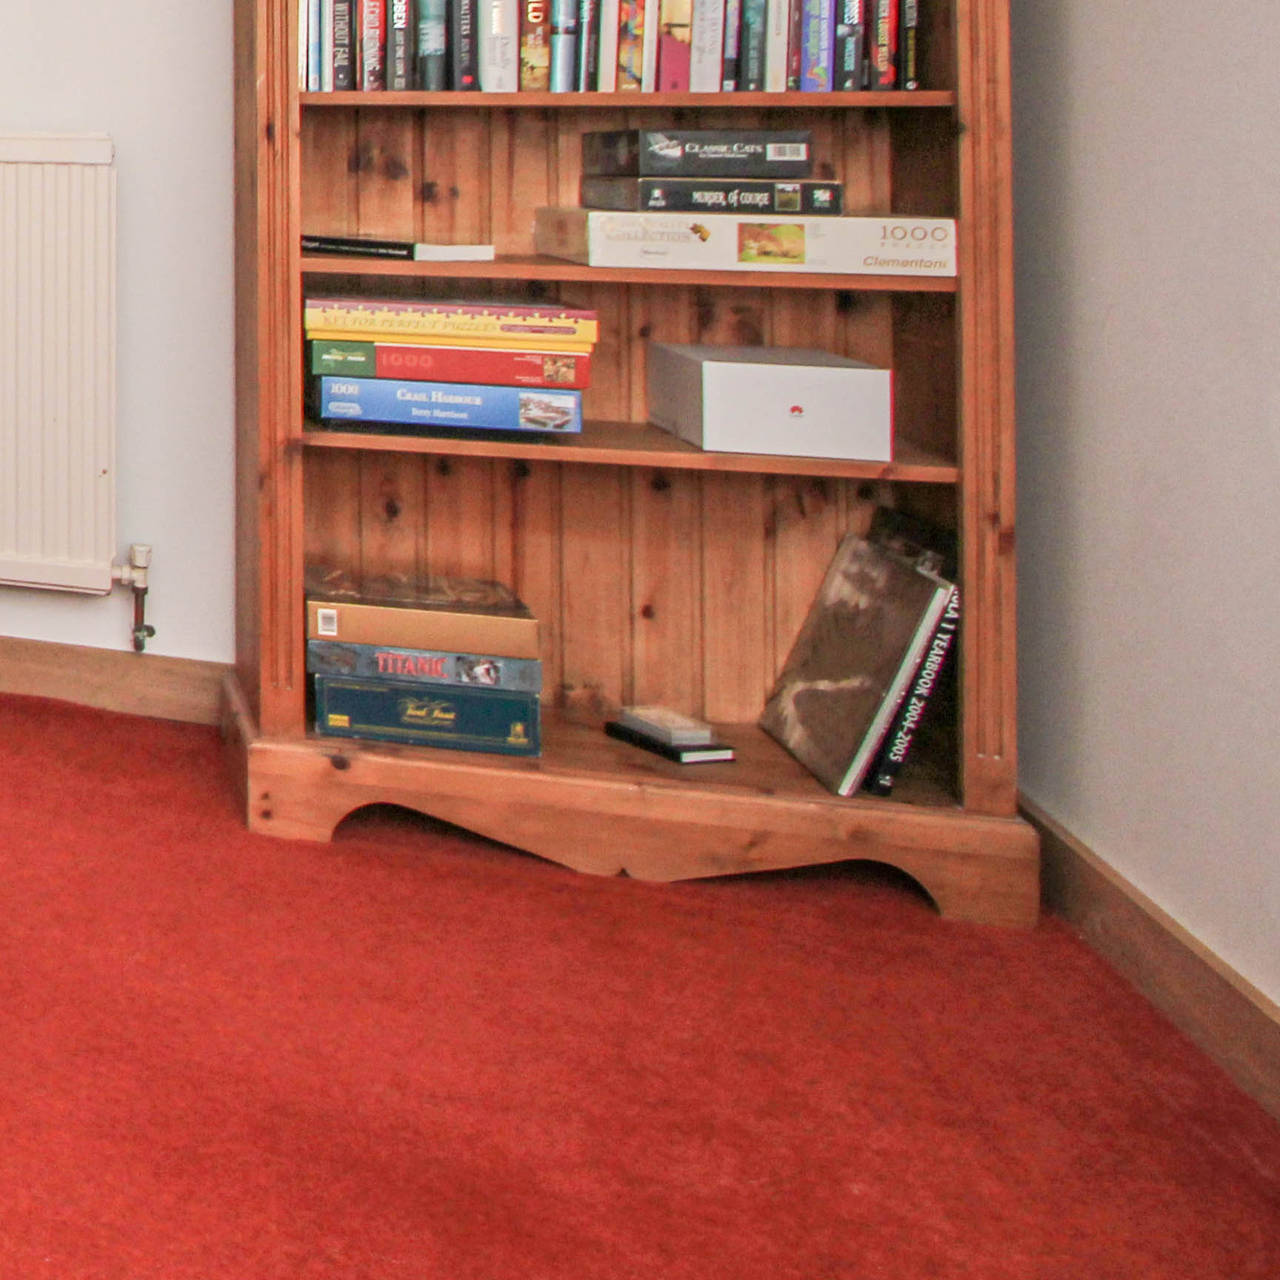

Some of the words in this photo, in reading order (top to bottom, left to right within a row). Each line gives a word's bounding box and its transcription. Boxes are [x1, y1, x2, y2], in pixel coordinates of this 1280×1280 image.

[335, 2, 349, 44] WITHOUT
[334, 47, 349, 67] FAIL
[880, 224, 949, 243] 1000
[862, 255, 948, 271] Clementoni
[382, 353, 433, 368] 1000
[330, 383, 359, 395] 1000
[375, 651, 449, 678] TITANIC
[915, 633, 953, 695] YEARBOOK
[890, 698, 925, 763] 2004-2005
